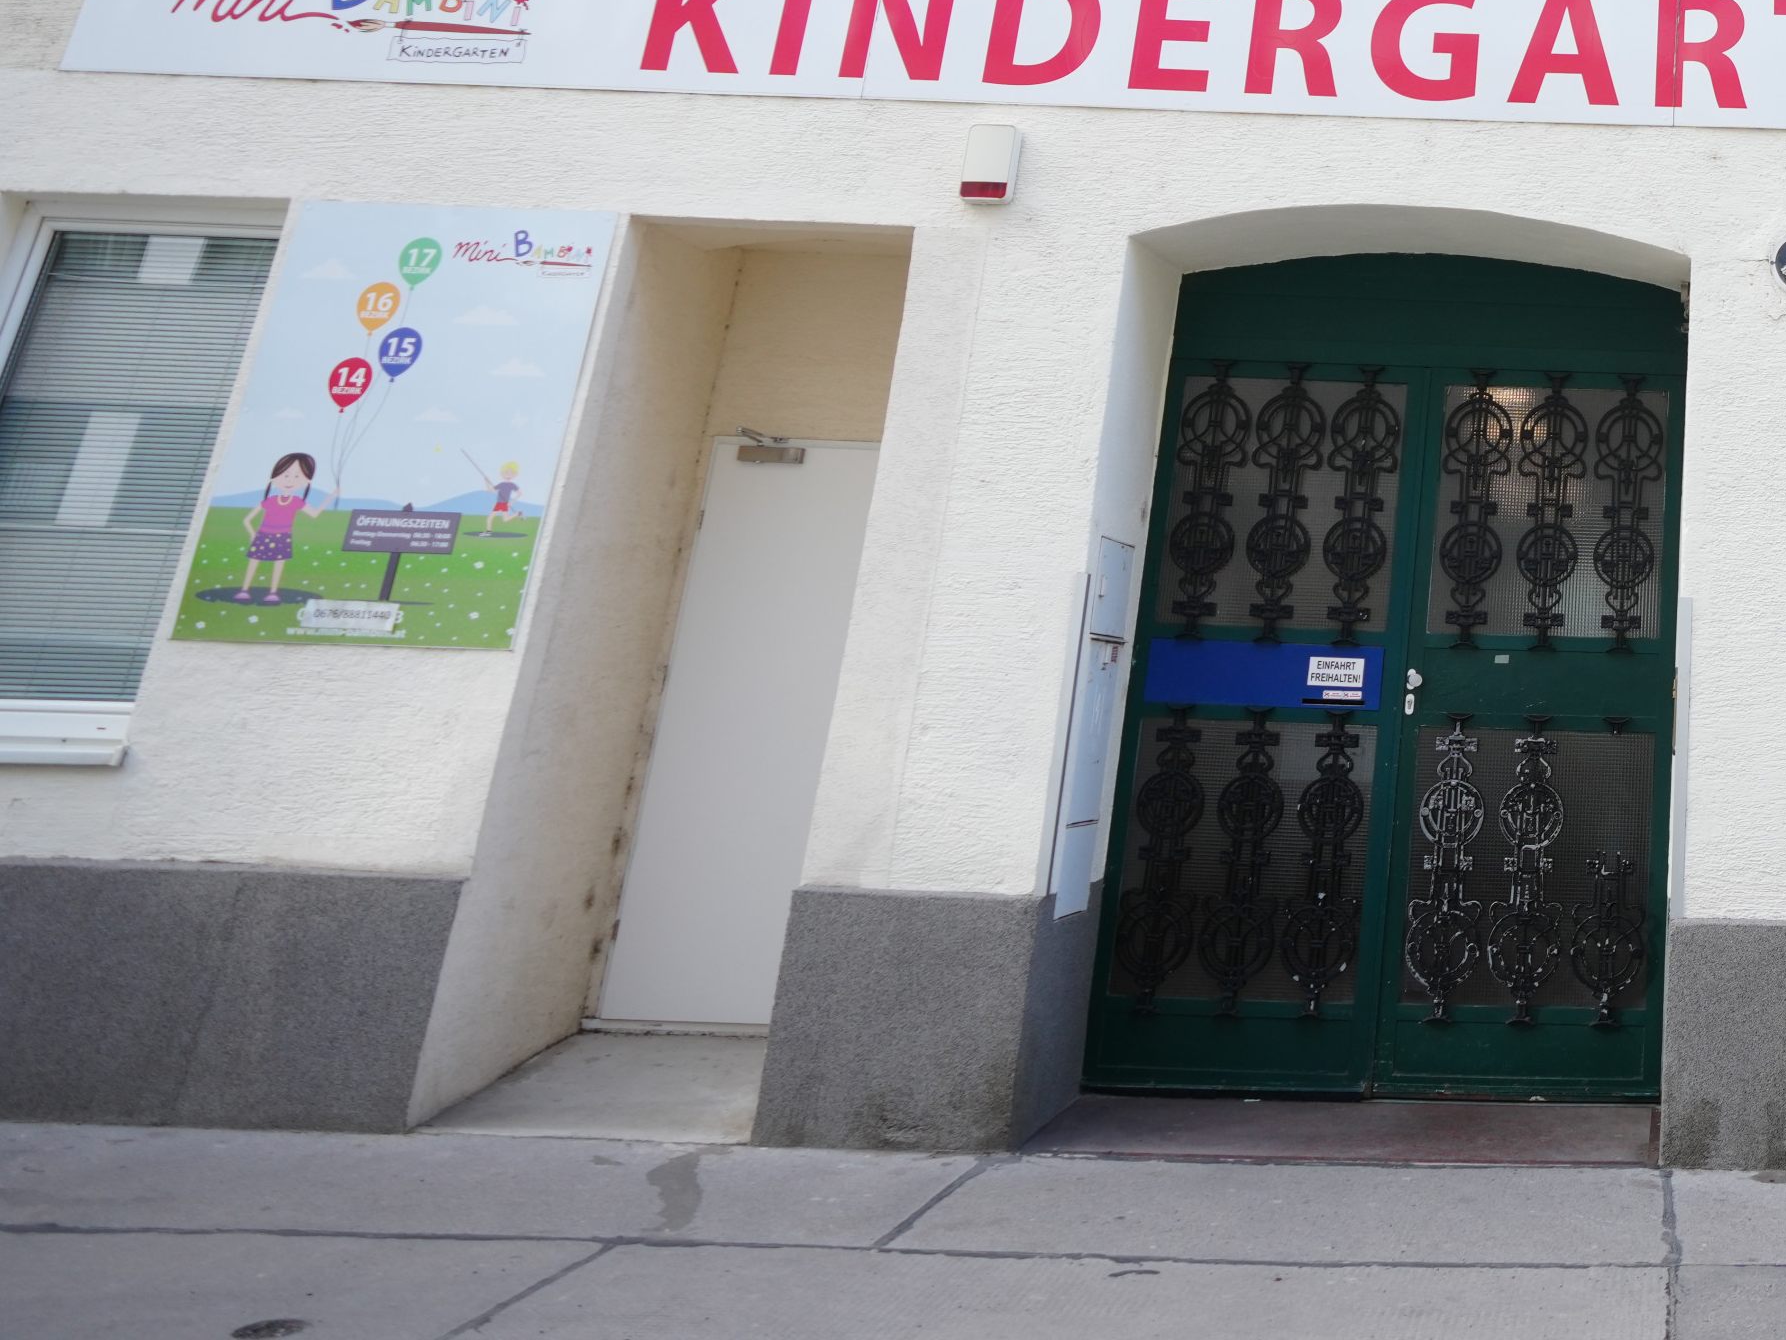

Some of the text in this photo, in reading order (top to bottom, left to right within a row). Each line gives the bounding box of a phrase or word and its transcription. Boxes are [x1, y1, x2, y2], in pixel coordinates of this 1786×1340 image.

[407, 248, 437, 267] 17
[366, 292, 394, 311] 16
[387, 337, 417, 357] 15
[337, 367, 367, 387] 14
[356, 515, 450, 529] ÖFFNUNGSZEITEN
[1316, 660, 1356, 671] EINFAHRT
[1310, 672, 1361, 683] FREIHALTEN!
